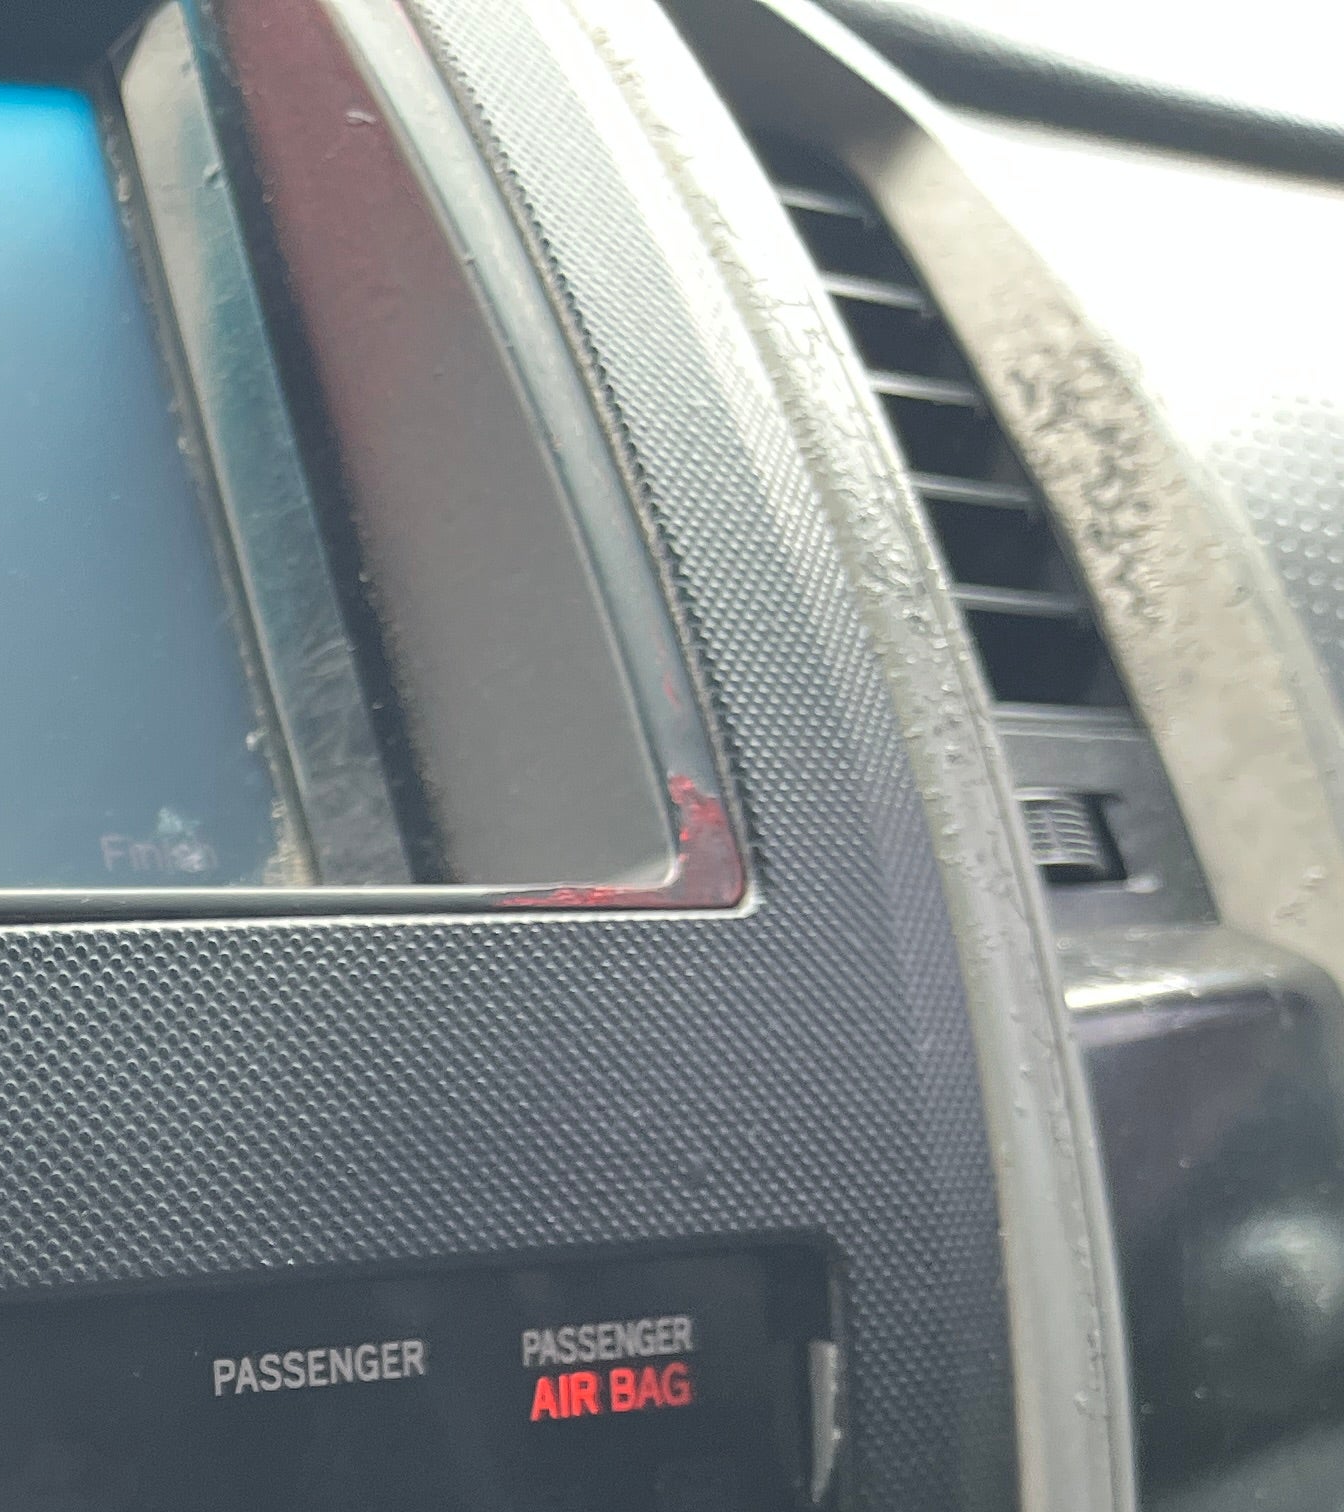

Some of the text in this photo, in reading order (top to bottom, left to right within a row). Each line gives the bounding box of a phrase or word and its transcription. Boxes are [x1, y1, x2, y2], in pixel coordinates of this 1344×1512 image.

[213, 1339, 426, 1397] PASSENGER
[522, 1315, 693, 1367] PASSENGER
[530, 1362, 693, 1422] AIR BAG
